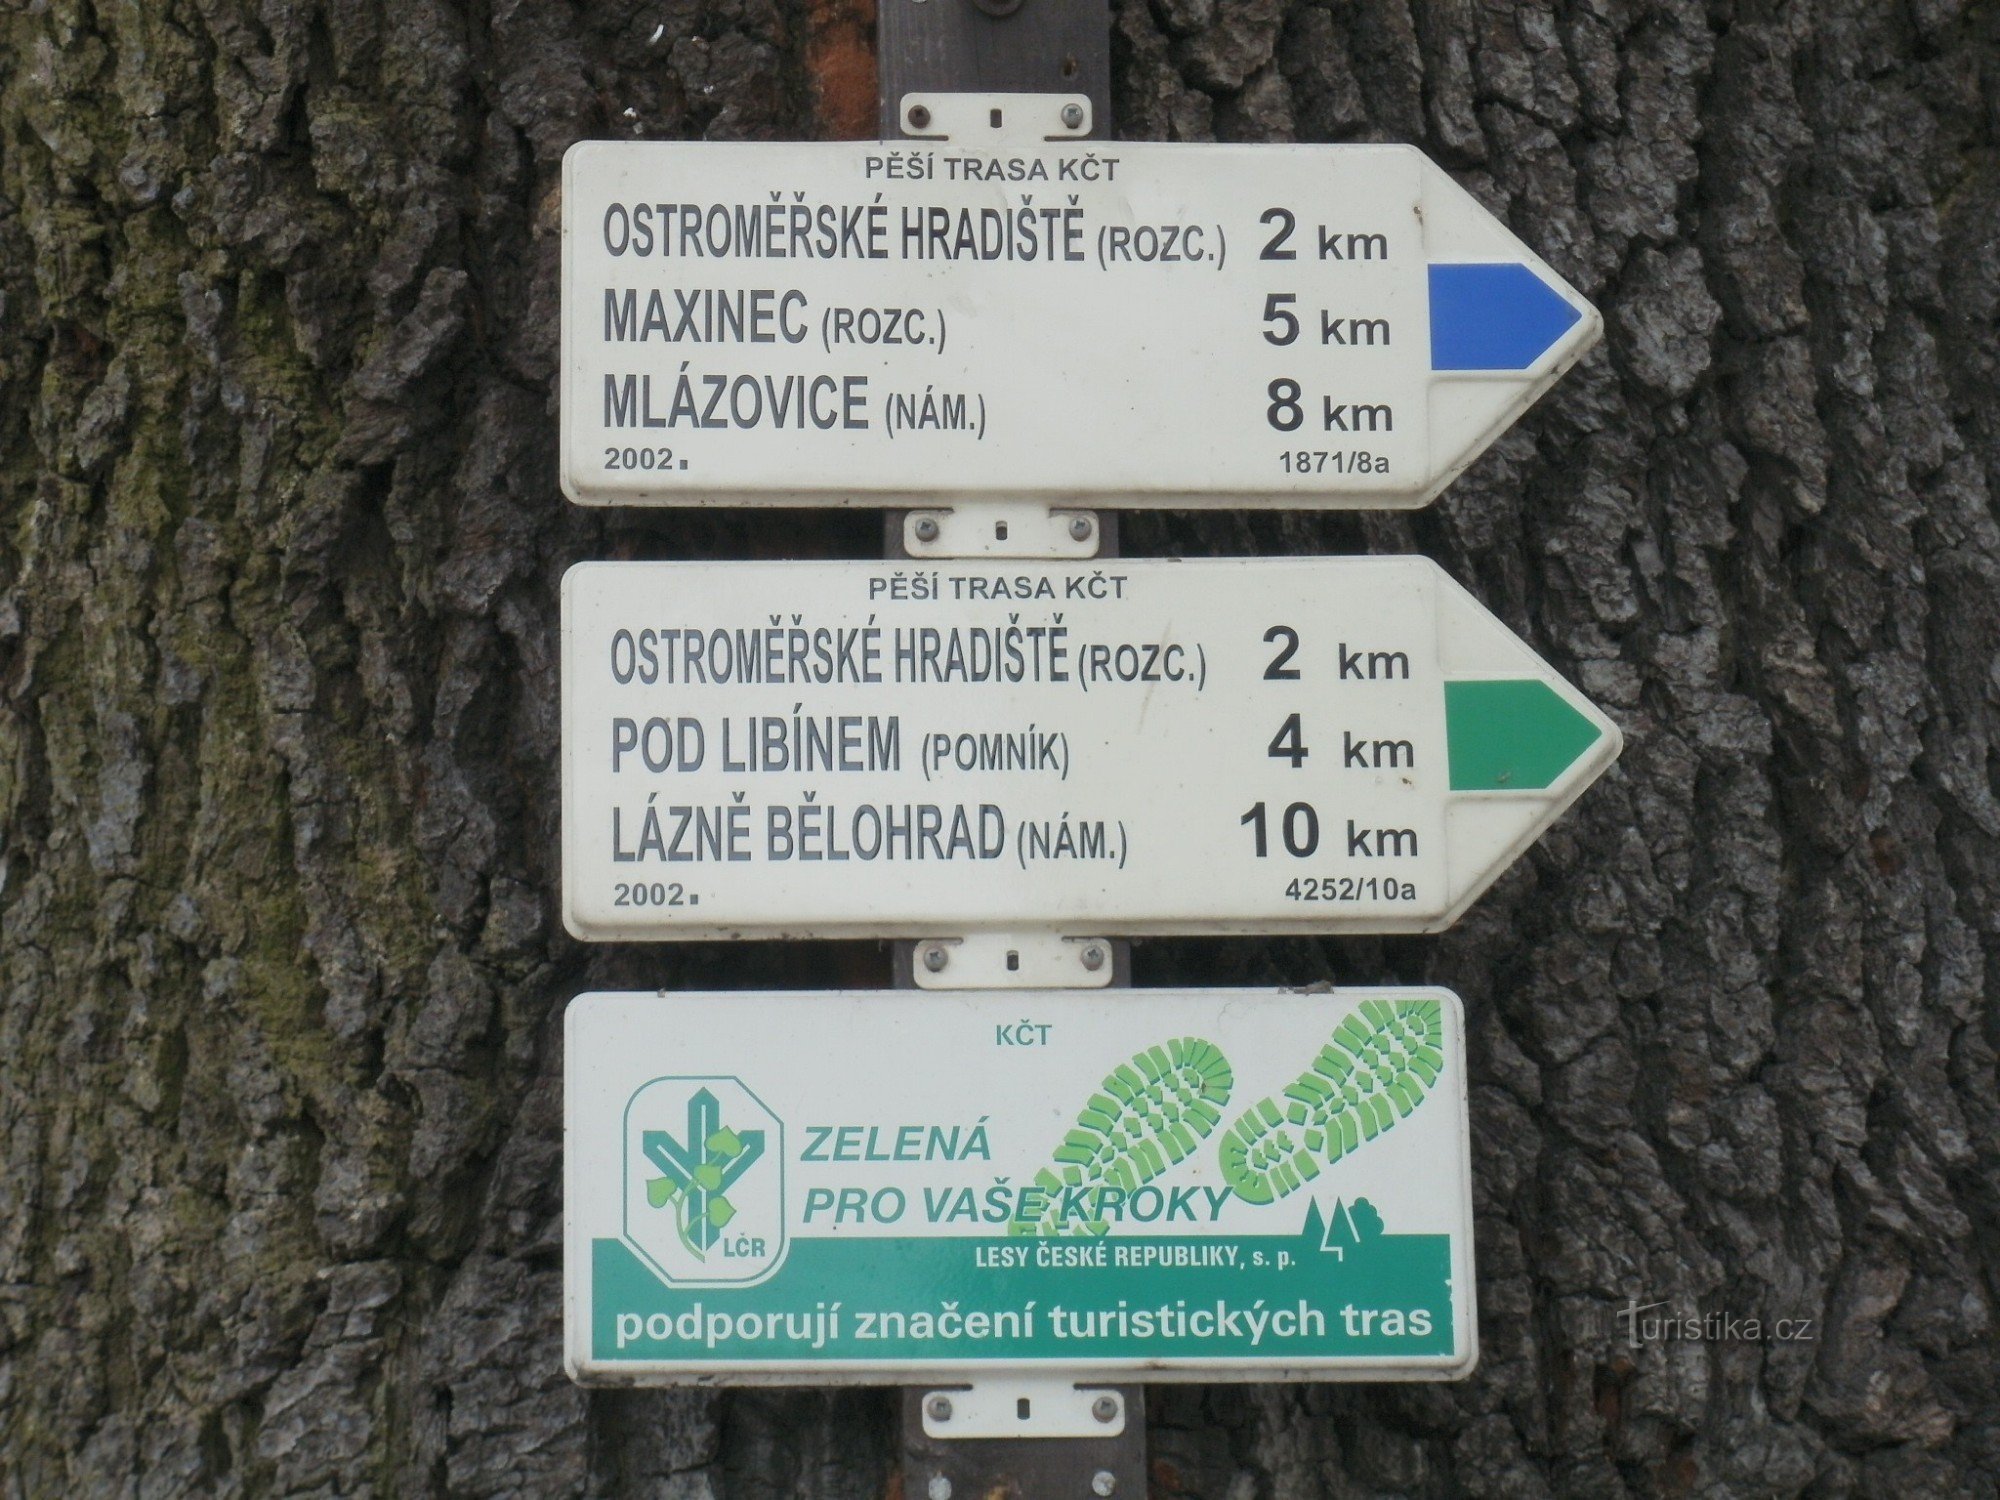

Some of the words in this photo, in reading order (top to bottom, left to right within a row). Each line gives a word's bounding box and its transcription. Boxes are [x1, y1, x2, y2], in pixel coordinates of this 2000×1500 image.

[866, 152, 933, 179] PĚŠÍ
[944, 157, 1048, 181] TRASA
[1059, 153, 1119, 181] KČT
[604, 191, 889, 259] OSTROMĚŘSKÉ
[902, 194, 1084, 261] HRADIŠTĚ
[1097, 224, 1227, 271] (ROZC.)
[1259, 207, 1297, 261] 2
[1318, 225, 1388, 260] km
[604, 288, 808, 343] MAXINEC
[822, 308, 946, 354] (ROZC.)
[1262, 293, 1300, 347] 5
[1321, 309, 1390, 346] km
[604, 361, 869, 429] MLÁZOVICE
[886, 385, 986, 440] (NÁM.)
[1266, 378, 1303, 432] 8
[1324, 395, 1393, 432] km
[1278, 451, 1390, 474] 1871/8a
[869, 571, 938, 600] PĚŠÍ
[948, 576, 1056, 600] TRASA
[1066, 570, 1128, 599] KČT
[611, 614, 882, 685] OSTROMĚŘSKÉ
[896, 612, 1069, 683] HRADIŠTĚ
[1078, 642, 1206, 692] (ROZC.)
[1263, 625, 1300, 680] 2
[1339, 643, 1409, 680] km
[613, 717, 705, 773] POD
[722, 702, 900, 772] LIBÍNEM
[922, 724, 1069, 781] (POMNÍK)
[1268, 713, 1308, 768] 4
[1344, 731, 1413, 768] km
[613, 791, 751, 863] LÁZNĚ
[768, 791, 1004, 861] BĚLOHRAD
[1017, 812, 1127, 869] (NÁM.)
[1241, 802, 1319, 858] 10
[1347, 820, 1418, 857] km
[1285, 877, 1417, 901] 4252/10a
[996, 1019, 1053, 1046] KČT
[800, 1115, 991, 1162] ZELENÁ
[803, 1187, 905, 1224] PRO
[923, 1177, 1045, 1224] VAŠE
[1060, 1186, 1233, 1223] KROKY
[724, 1232, 766, 1258] LČR
[975, 1246, 1028, 1268] LESY
[1036, 1240, 1107, 1268] ČESKÉ
[1115, 1245, 1245, 1270] REPUBLIKY,
[1252, 1250, 1272, 1267] s.
[1277, 1250, 1296, 1271] p.
[617, 1301, 842, 1349] podporují
[854, 1301, 1037, 1338] značení
[1048, 1300, 1326, 1346] turistických
[1340, 1303, 1433, 1337] tras
